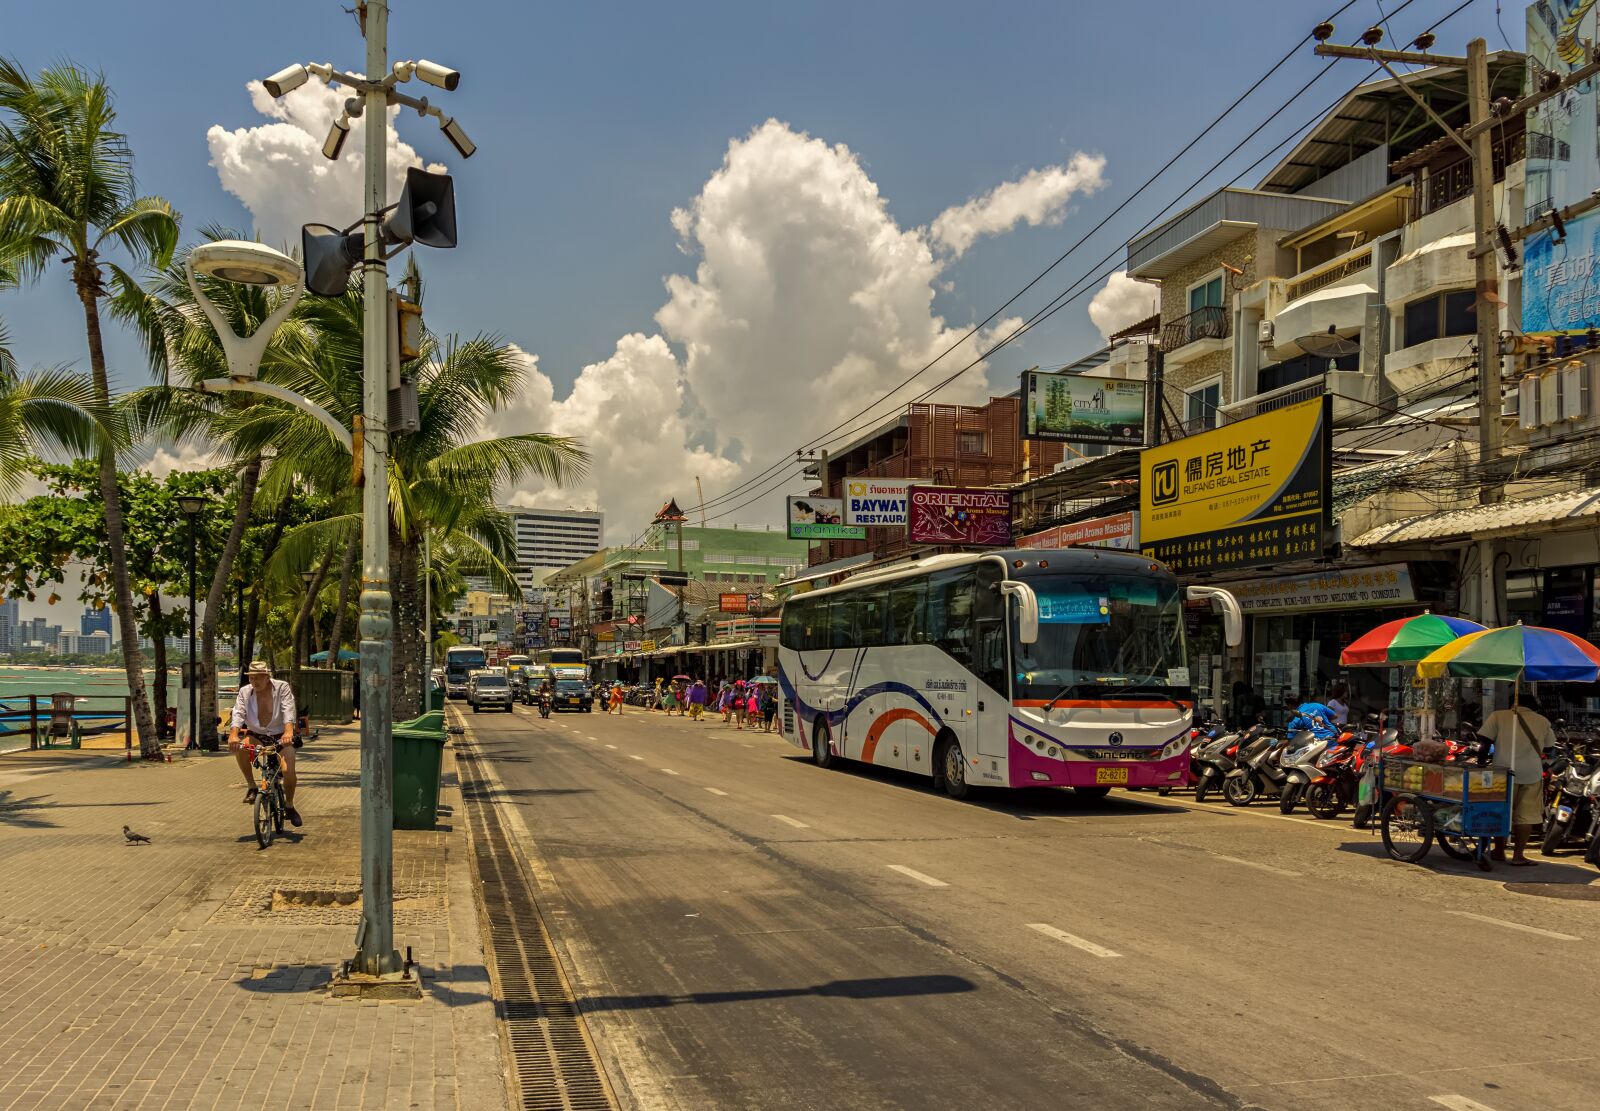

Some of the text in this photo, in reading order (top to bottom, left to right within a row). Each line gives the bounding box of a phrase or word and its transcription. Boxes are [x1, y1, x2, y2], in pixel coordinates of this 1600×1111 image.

[1073, 400, 1093, 409] CITY
[1185, 439, 1271, 482] 儒房地产
[1184, 465, 1270, 495] RUFANG REAL ESTATE
[869, 484, 908, 495] ร้านอาหารเ
[912, 492, 1010, 508] ORIENTAL
[1062, 521, 1131, 542] Oriental Aroma Massage
[1371, 588, 1401, 601] CONSULT
[1547, 602, 1561, 610] ATM
